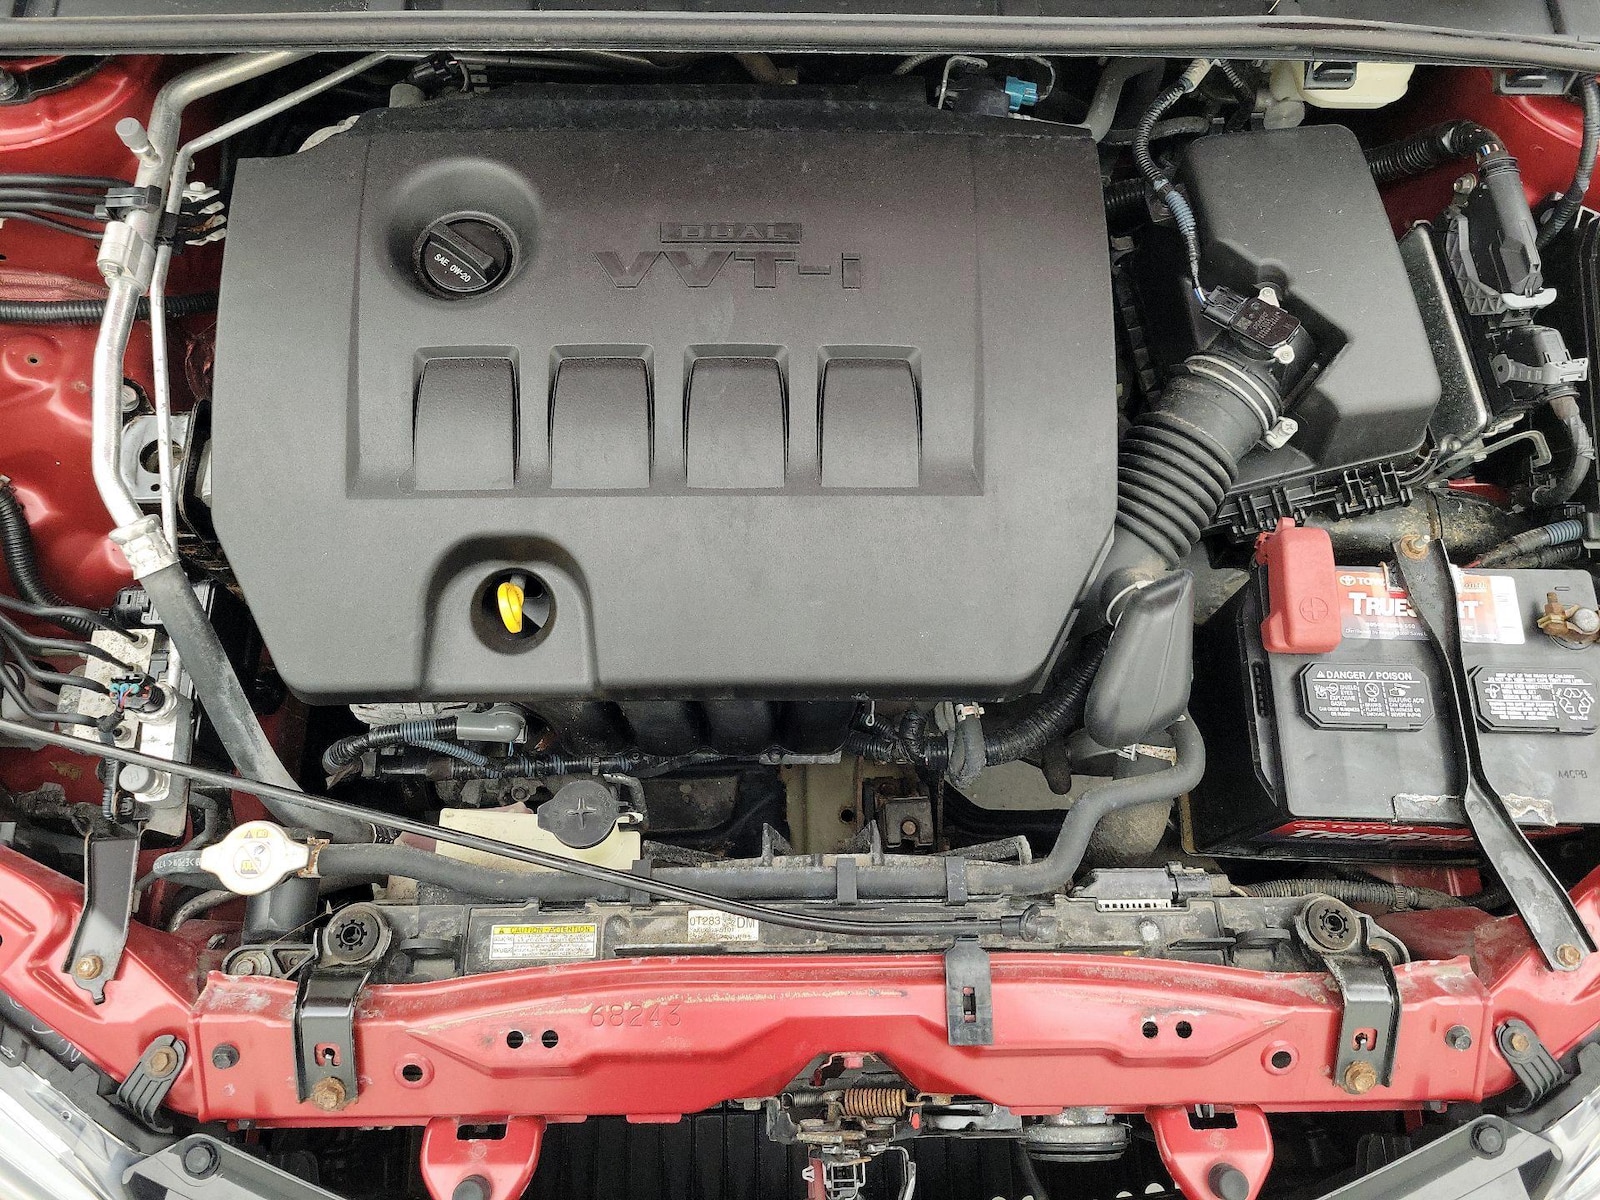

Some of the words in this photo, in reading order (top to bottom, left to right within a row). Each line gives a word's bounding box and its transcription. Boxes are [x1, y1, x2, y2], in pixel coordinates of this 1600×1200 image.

[680, 224, 789, 239] DUAL
[434, 253, 450, 267] SAE
[594, 250, 861, 289] VVT-i
[1326, 671, 1366, 679] DANGER
[1375, 672, 1412, 680] POISON
[510, 926, 543, 934] CAUTION
[549, 925, 591, 933] ATTENTION
[590, 1003, 681, 1027] 68243
